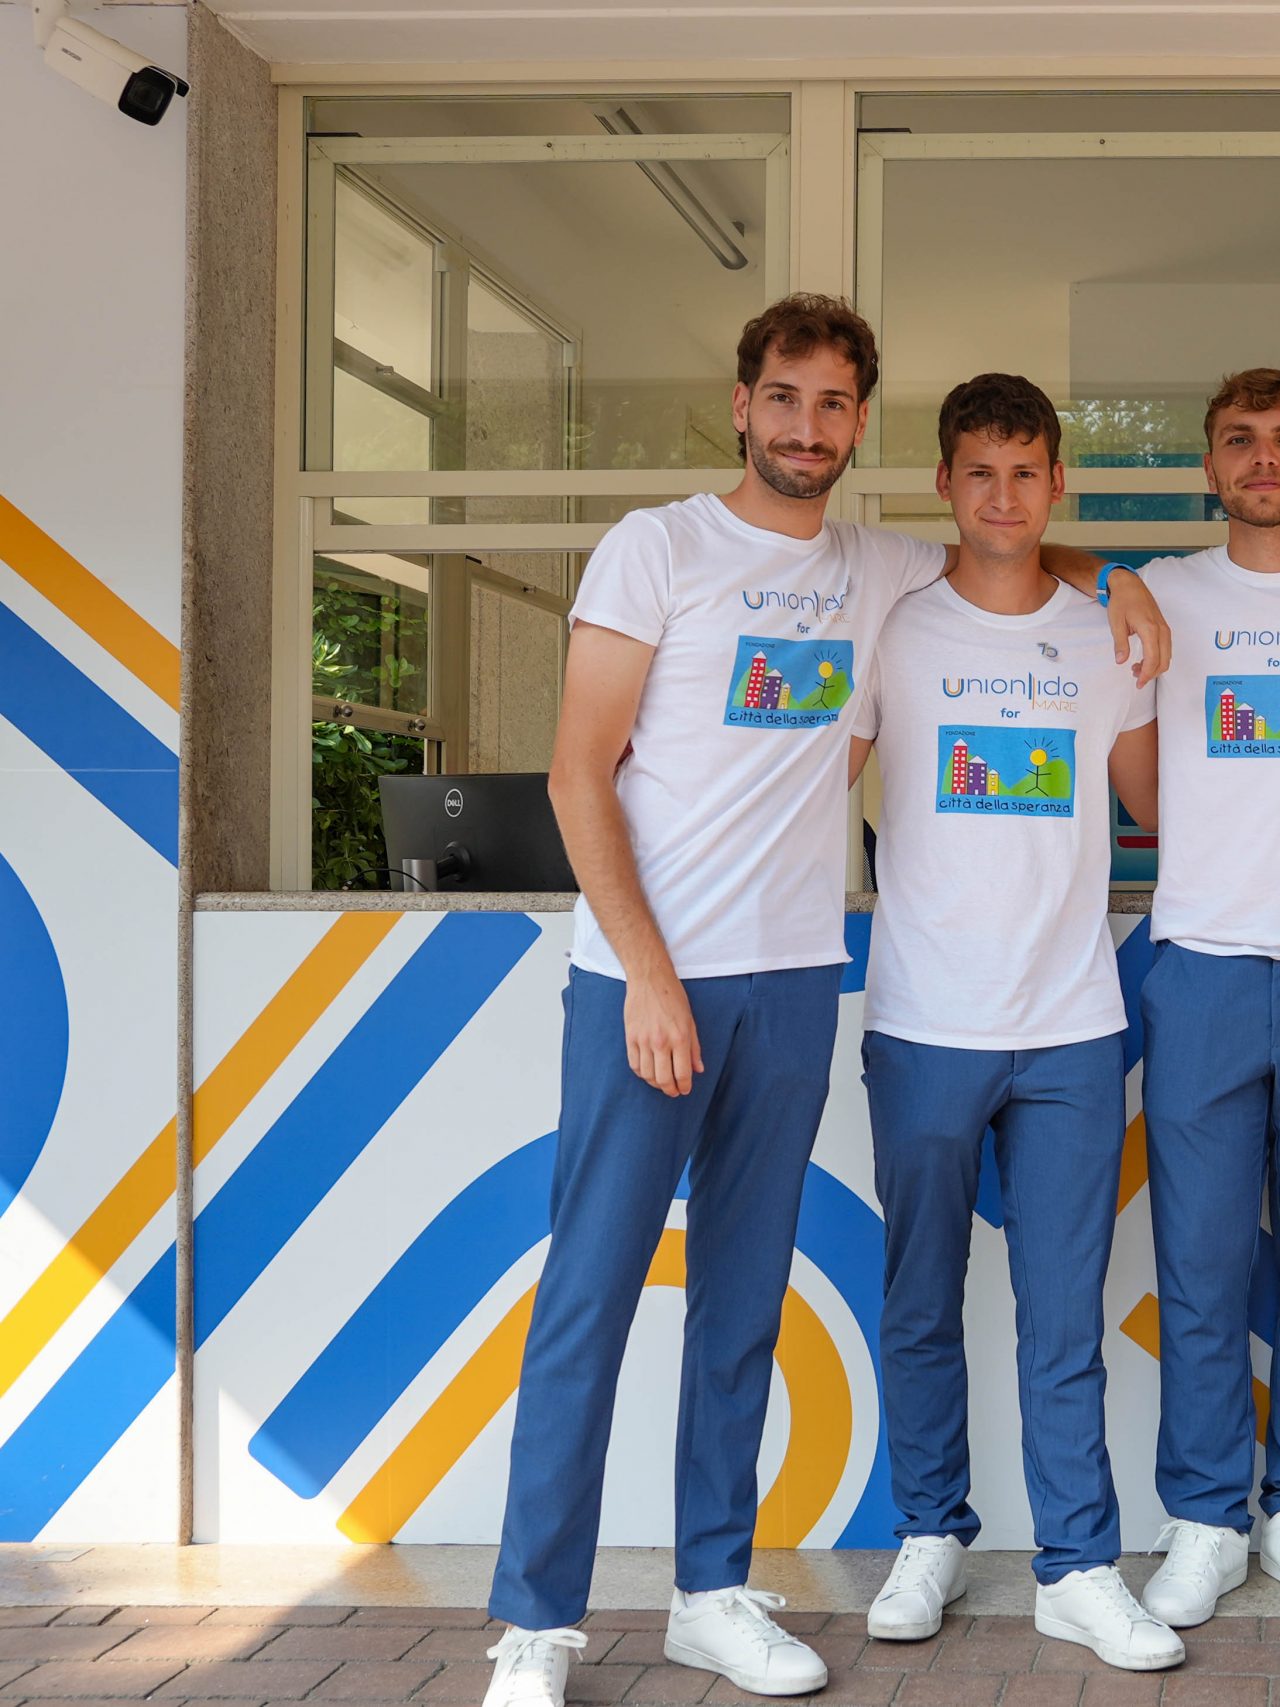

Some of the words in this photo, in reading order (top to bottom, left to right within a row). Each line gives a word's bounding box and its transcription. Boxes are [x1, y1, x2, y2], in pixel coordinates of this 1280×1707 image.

[797, 621, 812, 635] for
[1000, 707, 1020, 719] for
[1034, 701, 1079, 713] MARE
[727, 710, 762, 724] città
[765, 712, 797, 725] della
[1210, 743, 1241, 755] città
[1244, 743, 1275, 755] della
[939, 797, 972, 809] città
[975, 799, 1009, 811] della
[1011, 800, 1071, 814] speranza
